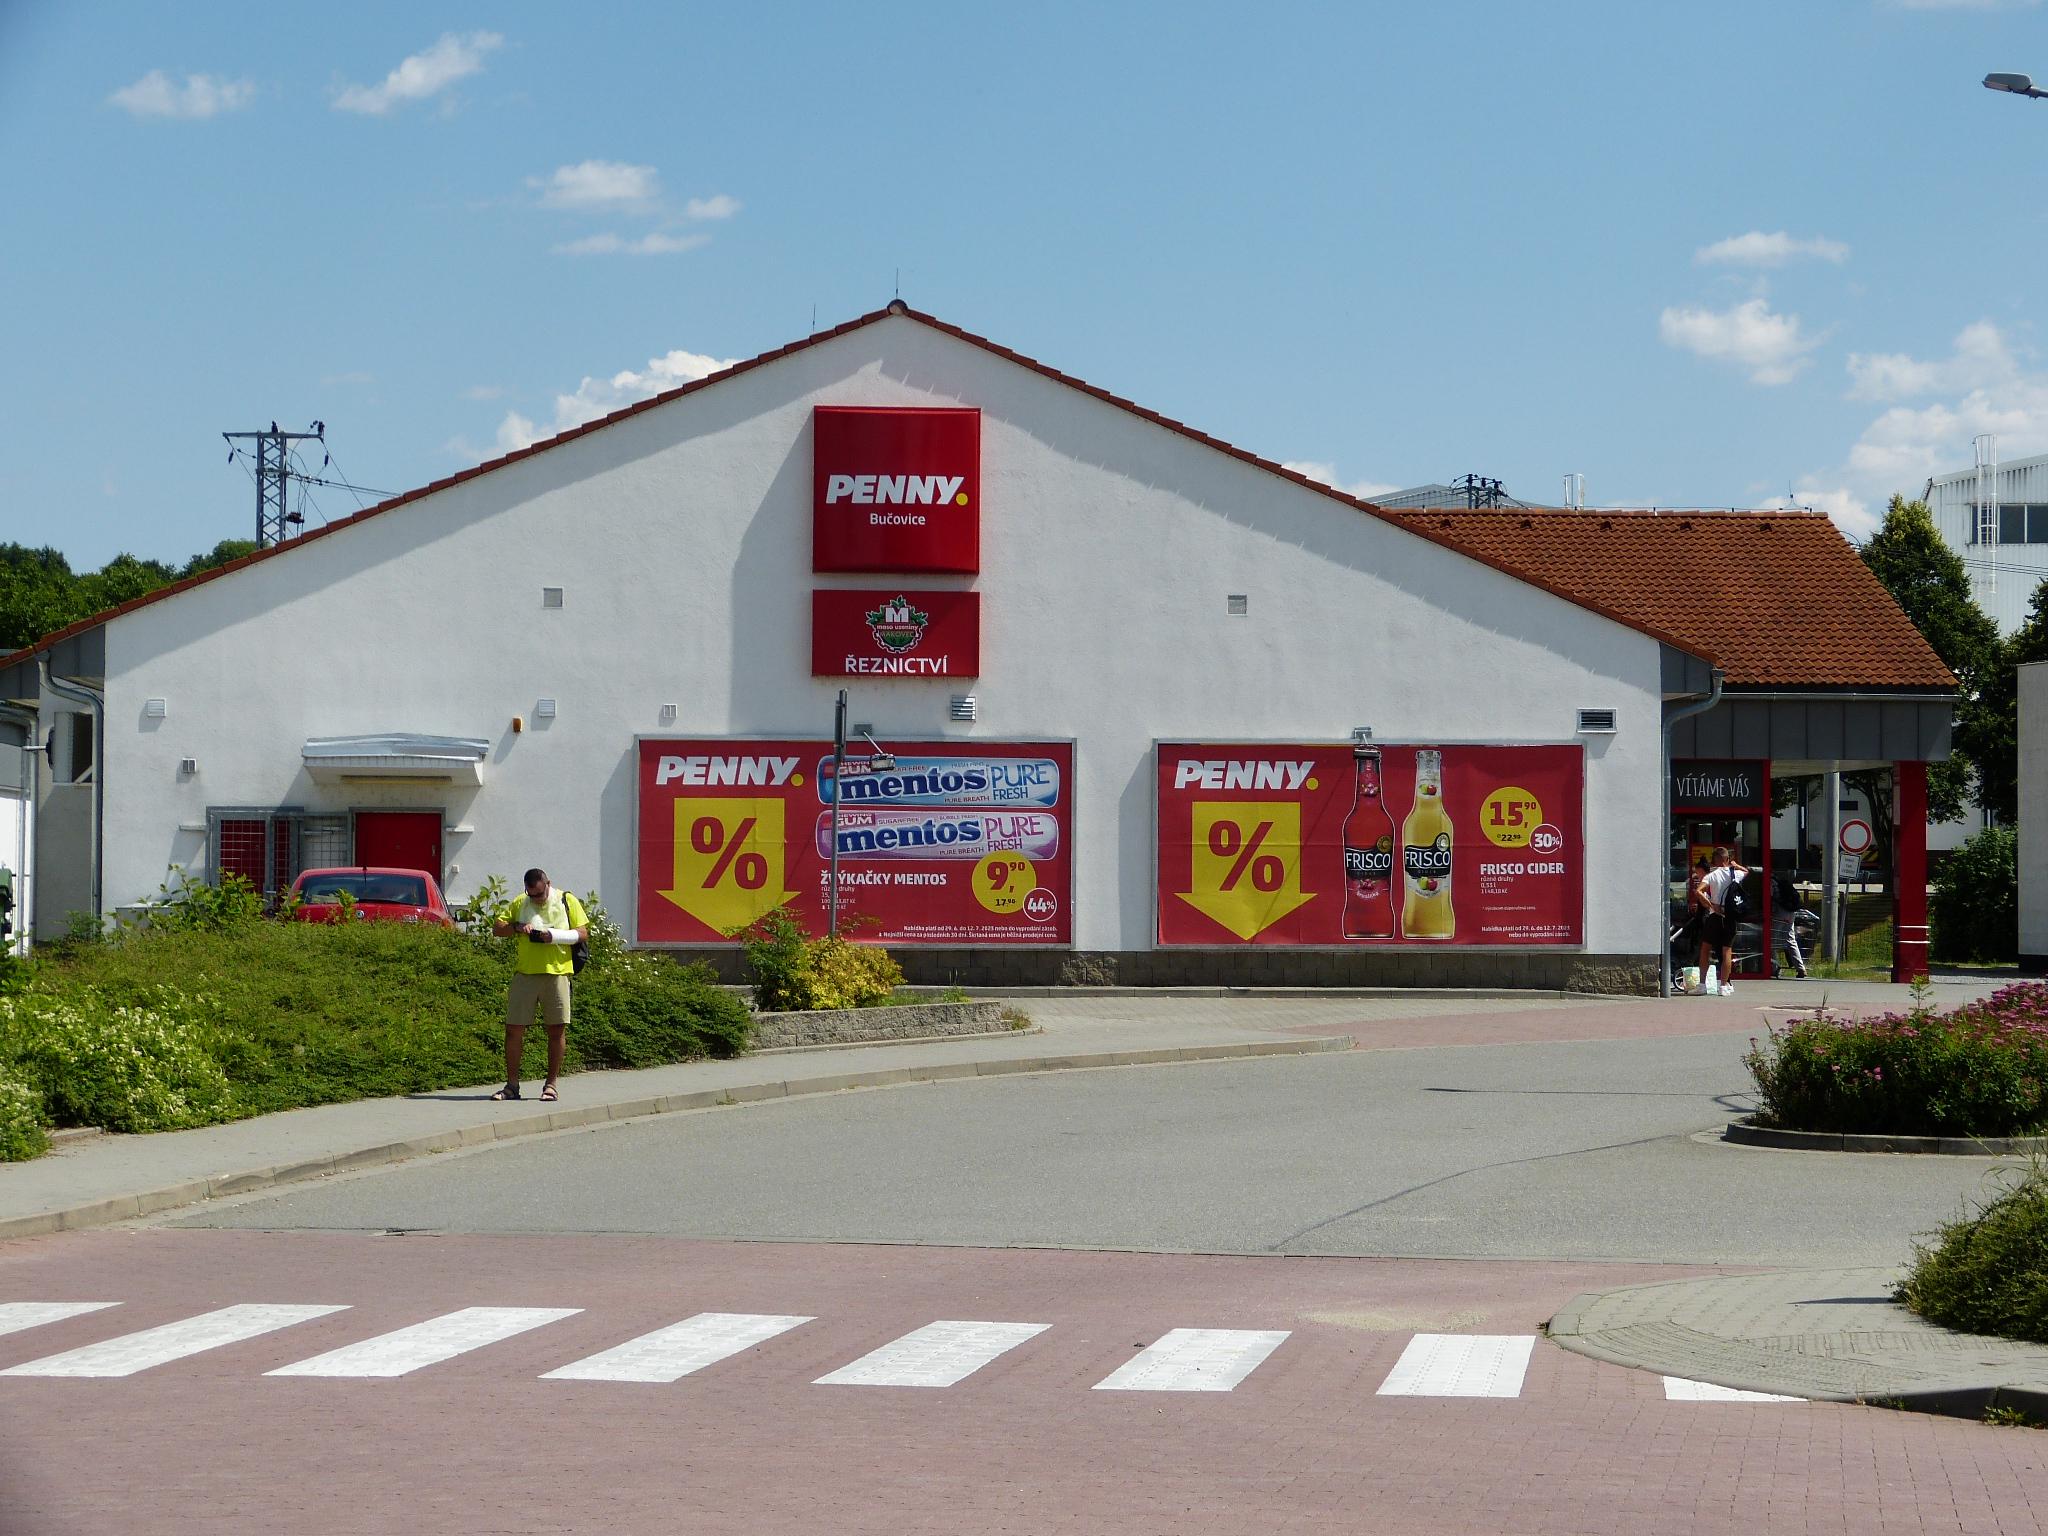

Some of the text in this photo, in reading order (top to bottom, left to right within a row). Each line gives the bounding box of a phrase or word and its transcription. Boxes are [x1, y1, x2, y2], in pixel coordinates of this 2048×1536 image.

[870, 513, 926, 525] Bučovice
[885, 607, 909, 623] M
[845, 654, 948, 674] ŘEZNICTVÍ
[839, 767, 987, 800] mentos
[990, 763, 1050, 789] PURE
[993, 786, 1029, 801] FRESH
[1677, 773, 1750, 798] VÍTÁME VÁS
[838, 819, 981, 853] mentos
[984, 815, 1044, 840] PURE
[987, 838, 1023, 852] FRESH
[1534, 833, 1560, 848] 30%
[690, 816, 769, 890] %
[958, 847, 984, 855] BREATH
[1208, 819, 1285, 893] %
[1345, 853, 1391, 870] FRISCO
[1404, 851, 1451, 869] FRISCO
[1480, 862, 1565, 875] FRISCO CIDER
[894, 873, 947, 885] MENTOS
[1027, 897, 1055, 912] 44%
